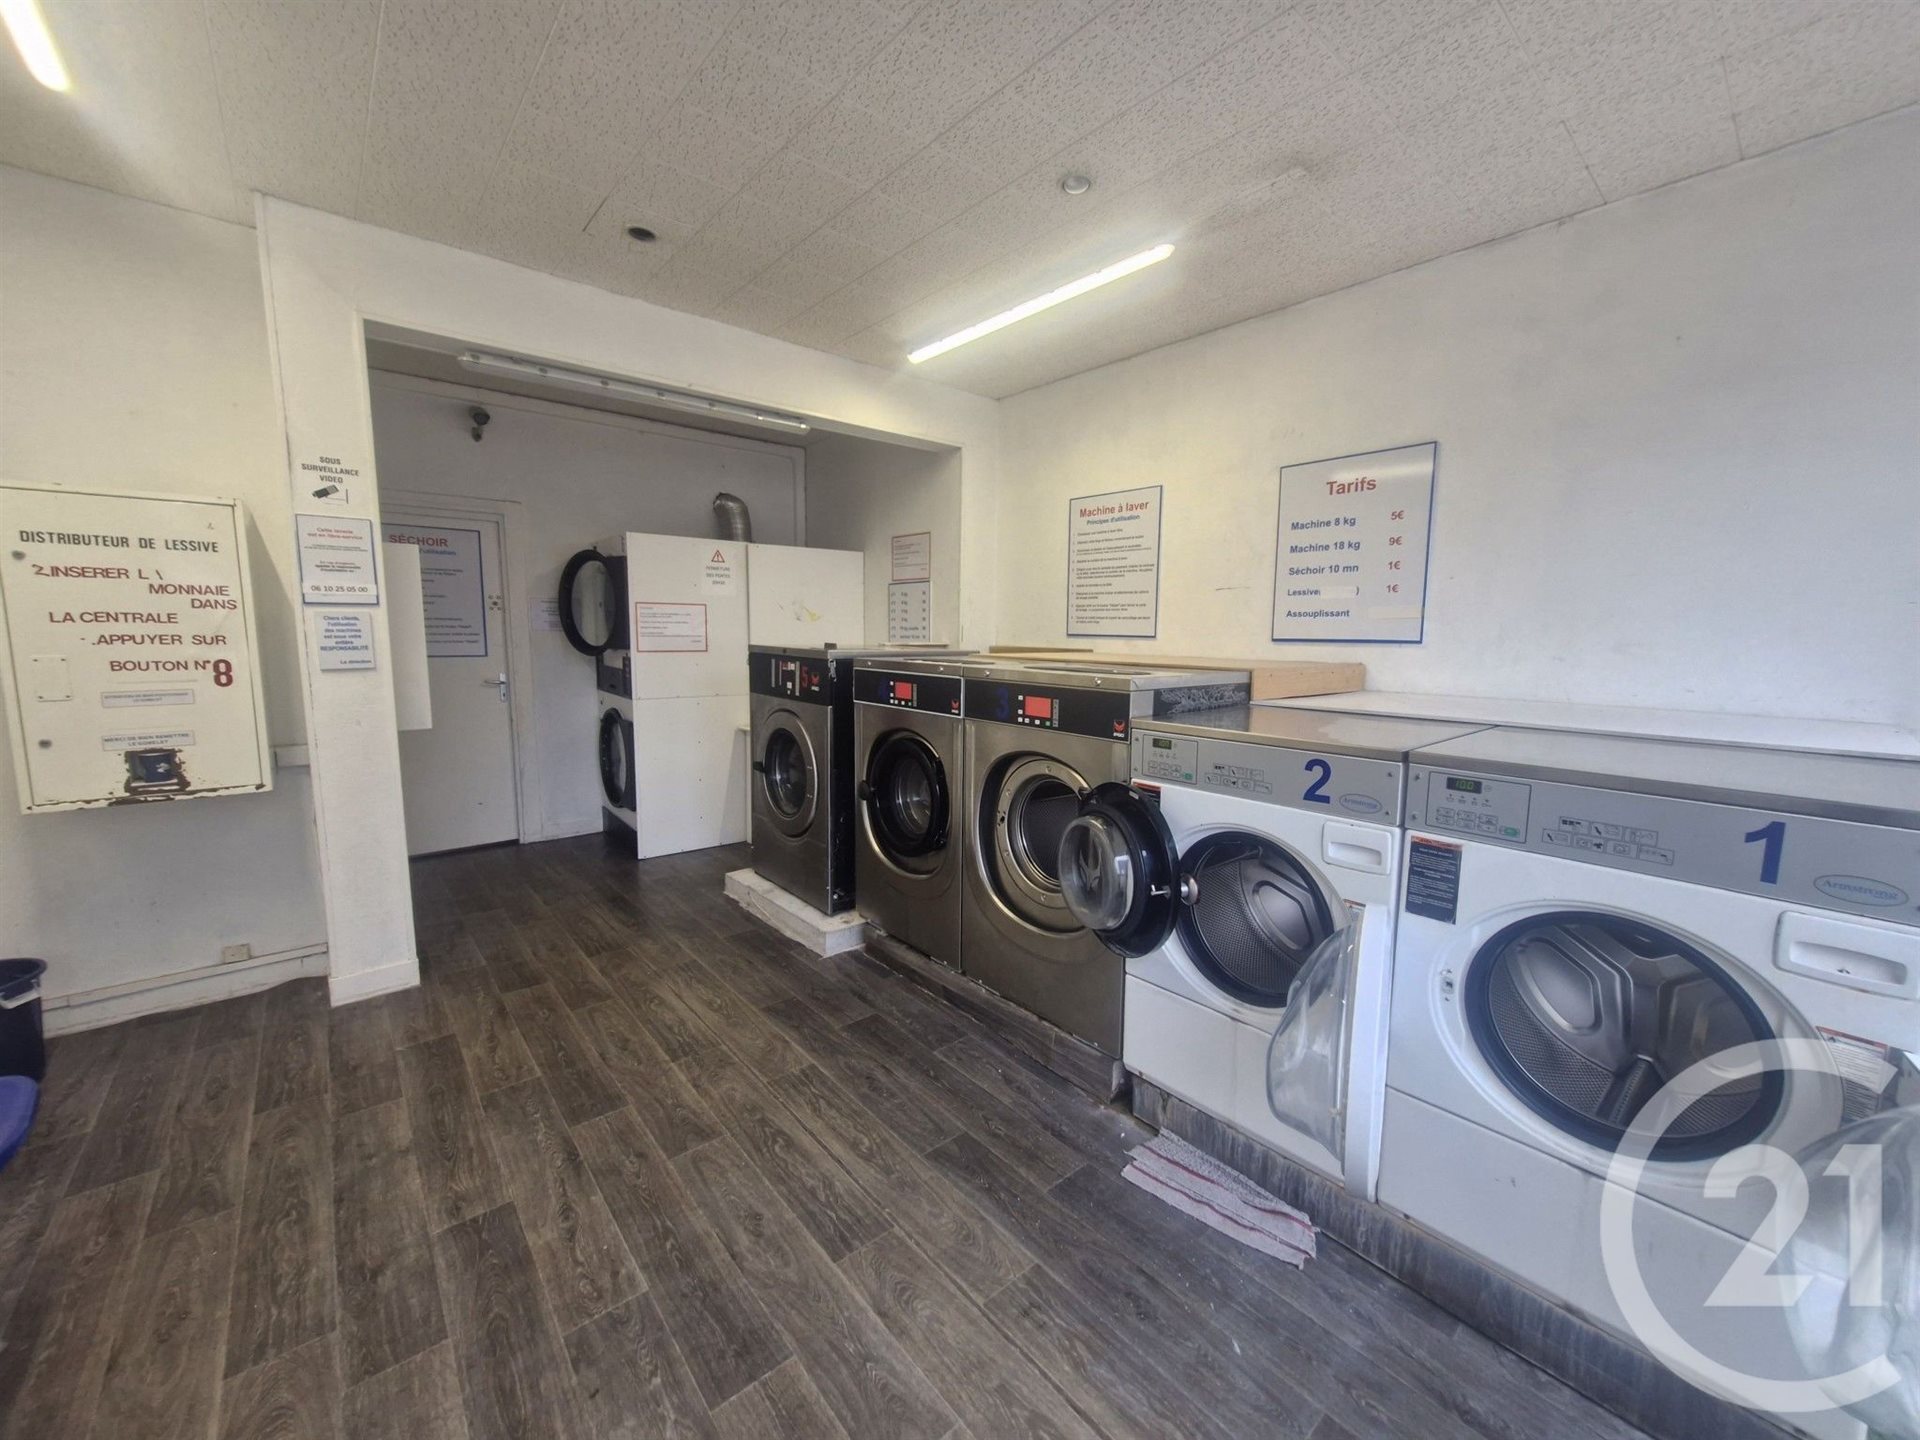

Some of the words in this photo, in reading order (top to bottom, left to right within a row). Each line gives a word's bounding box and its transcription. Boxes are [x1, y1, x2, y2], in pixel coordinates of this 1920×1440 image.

[319, 456, 342, 465] SOUS
[301, 463, 360, 476] SURVEILLANCE
[319, 475, 344, 484] VIDEO
[1326, 477, 1377, 496] Tarifs
[1079, 506, 1115, 518] Machine
[1126, 501, 1149, 511] laver
[1390, 510, 1405, 520] 5€
[1291, 519, 1331, 531] Machine
[1334, 518, 1341, 526] 8
[1343, 517, 1357, 527] kg
[19, 530, 130, 548] DISTRIBUTEUR
[139, 537, 156, 550] DE
[165, 539, 219, 553] LESSIVE
[1388, 536, 1403, 546] 9€
[1289, 543, 1330, 554] Machine
[1333, 542, 1345, 551] 18
[1347, 541, 1361, 551] kg
[1288, 565, 1326, 576] Séchoir
[1328, 565, 1340, 574] 10
[1342, 565, 1359, 573] mn
[1387, 560, 1401, 570] 1€
[149, 583, 230, 596] MONNAIE
[1386, 584, 1399, 593] 1€
[191, 598, 237, 610] DANS
[49, 612, 75, 623] LA
[80, 612, 179, 624] CENTRALE
[1286, 610, 1350, 619] Assouplissant
[192, 634, 227, 645] SUR
[110, 660, 188, 672] BOUTON
[212, 659, 234, 687] 8
[1302, 758, 1333, 805] 2
[1744, 821, 1787, 885] 1
[1822, 879, 1899, 901] Armstrong
